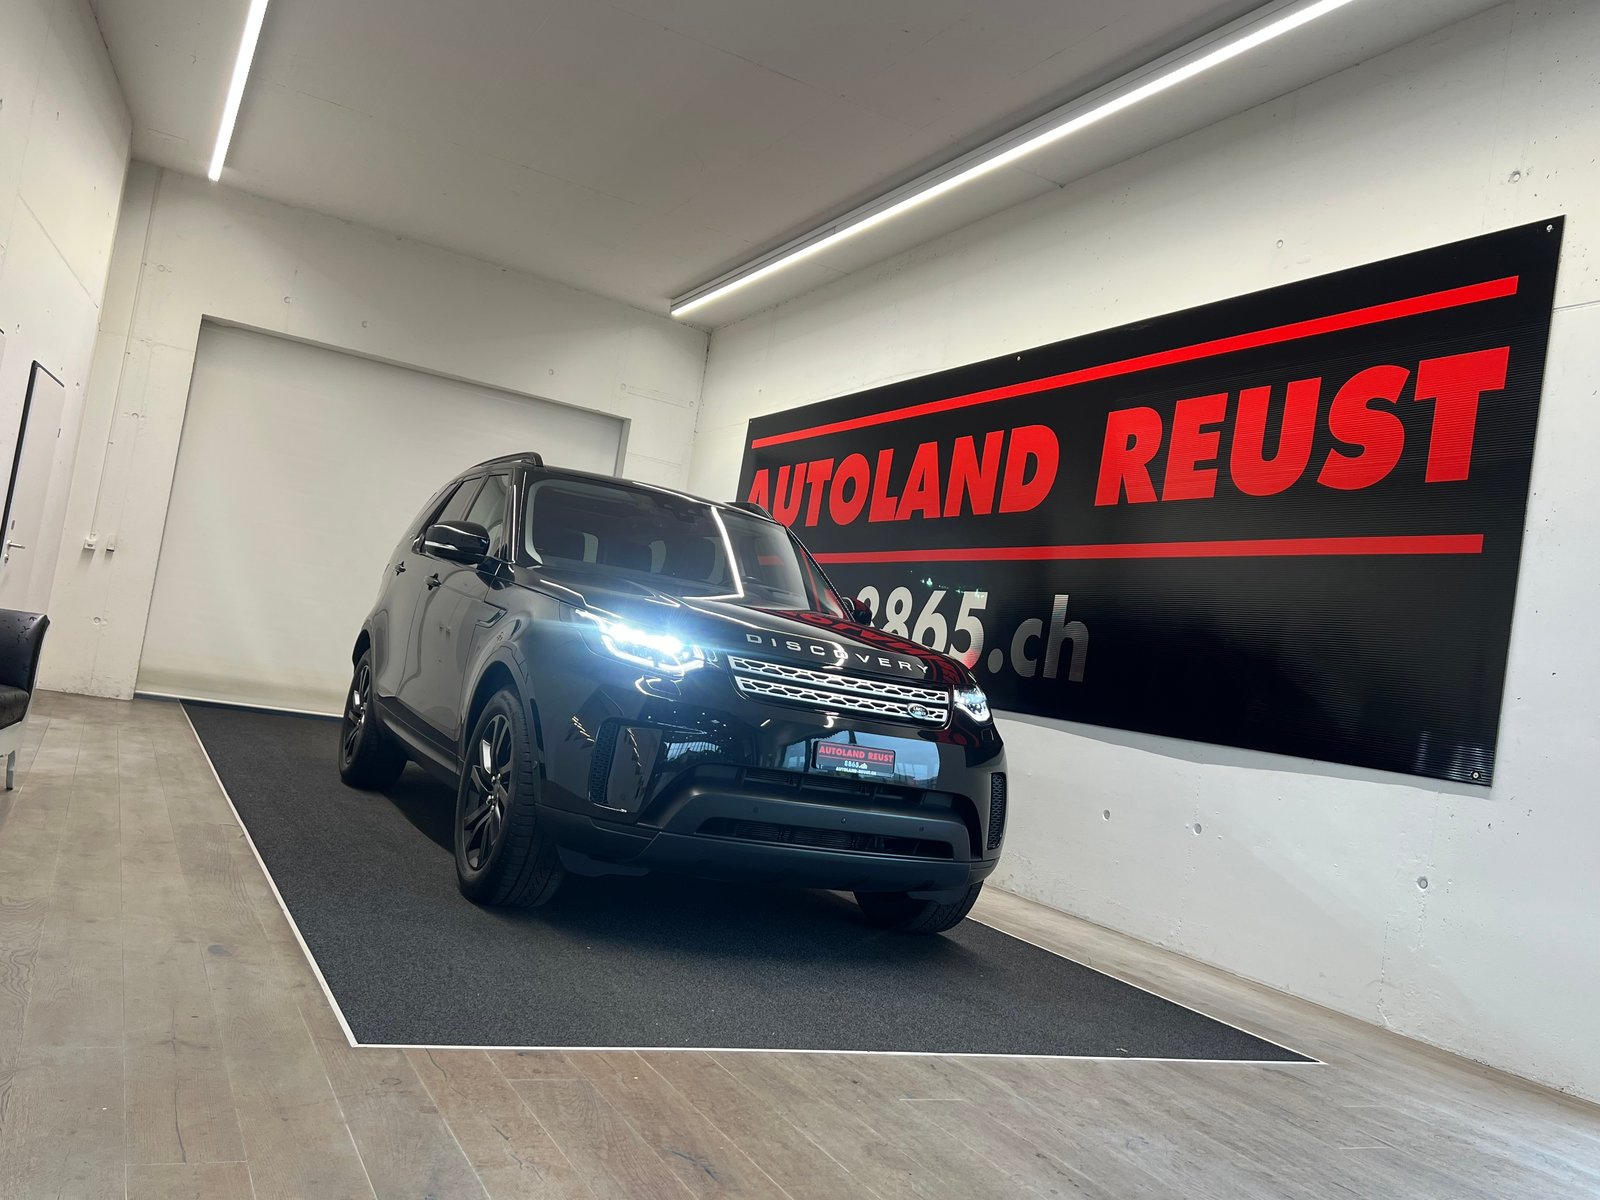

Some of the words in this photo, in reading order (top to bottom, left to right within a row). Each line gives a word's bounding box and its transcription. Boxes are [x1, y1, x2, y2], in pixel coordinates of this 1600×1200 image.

[748, 425, 1059, 527] AUTOLAND
[1094, 346, 1510, 506] REUST
[745, 633, 928, 673] DISCOVERY
[819, 745, 866, 759] AUTOLAND
[868, 751, 894, 762] REUST
